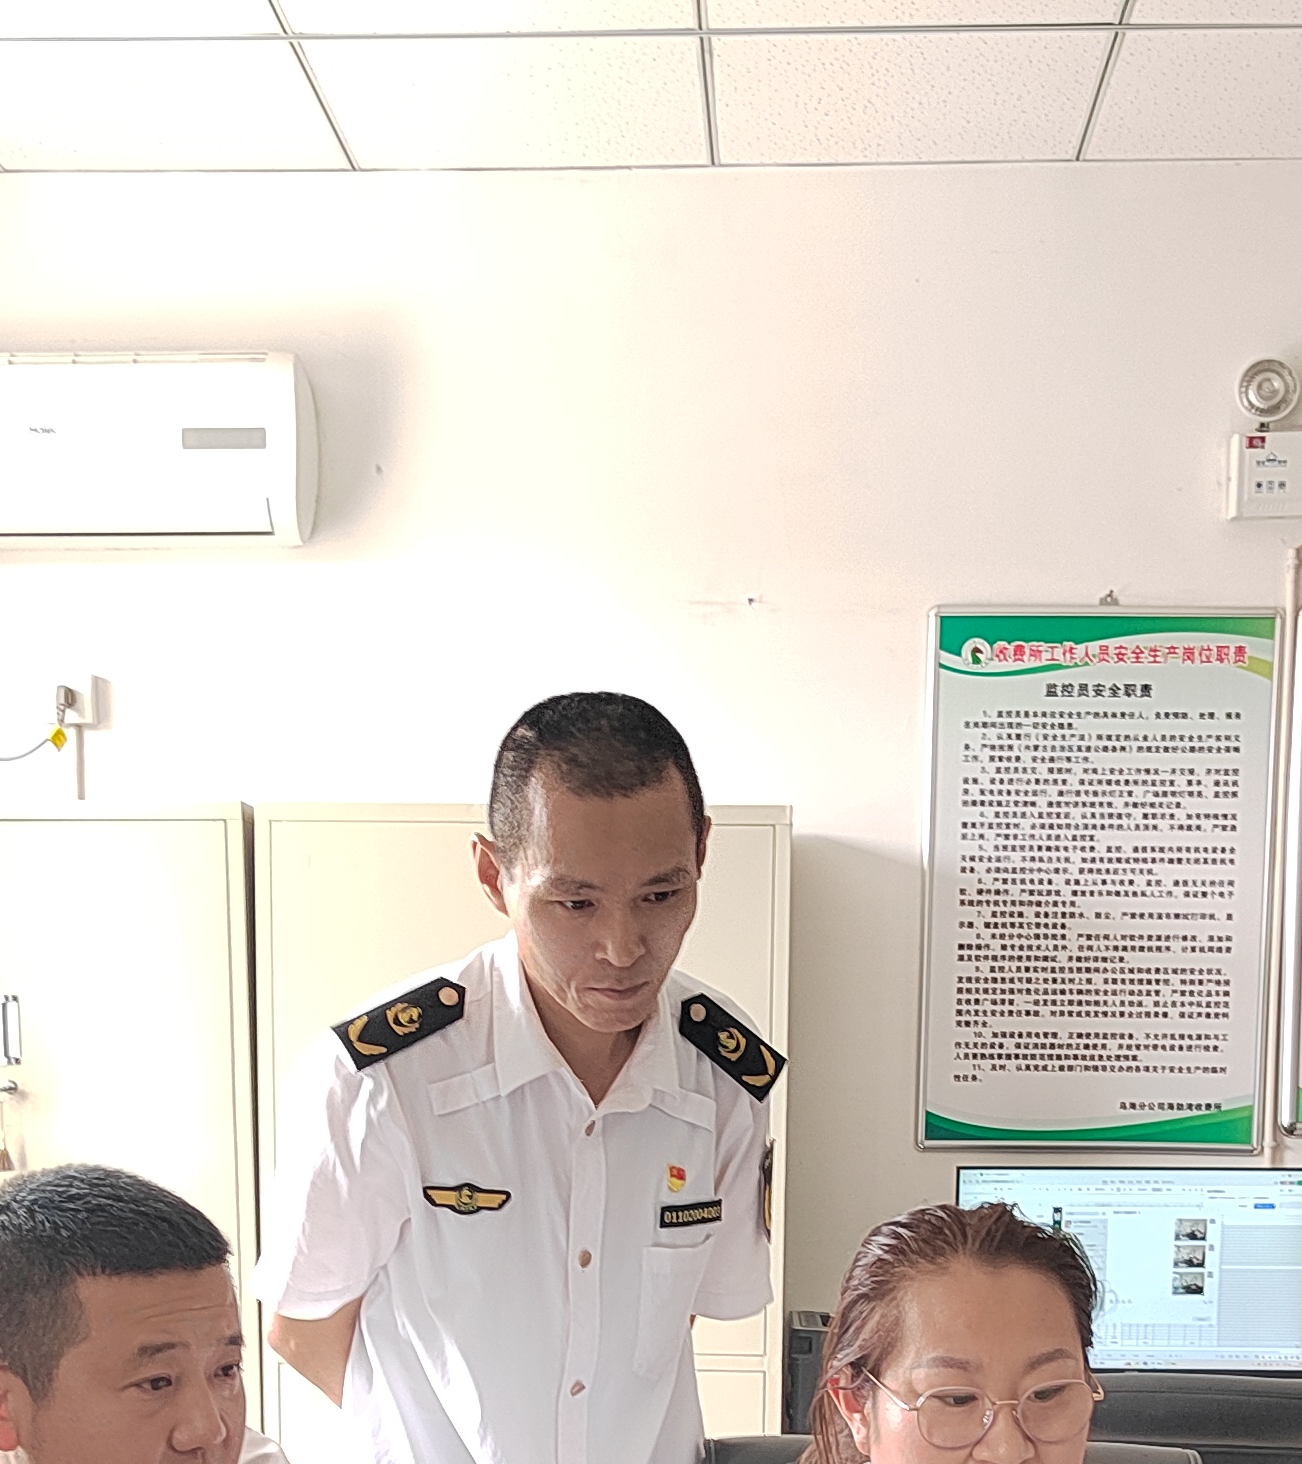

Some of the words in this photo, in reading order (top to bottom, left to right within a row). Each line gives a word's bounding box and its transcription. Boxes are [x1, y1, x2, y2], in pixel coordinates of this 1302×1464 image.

[994, 643, 1247, 665] 收费所工作人员安全生产岗位职责
[1045, 682, 1153, 698] 监控员安全职责
